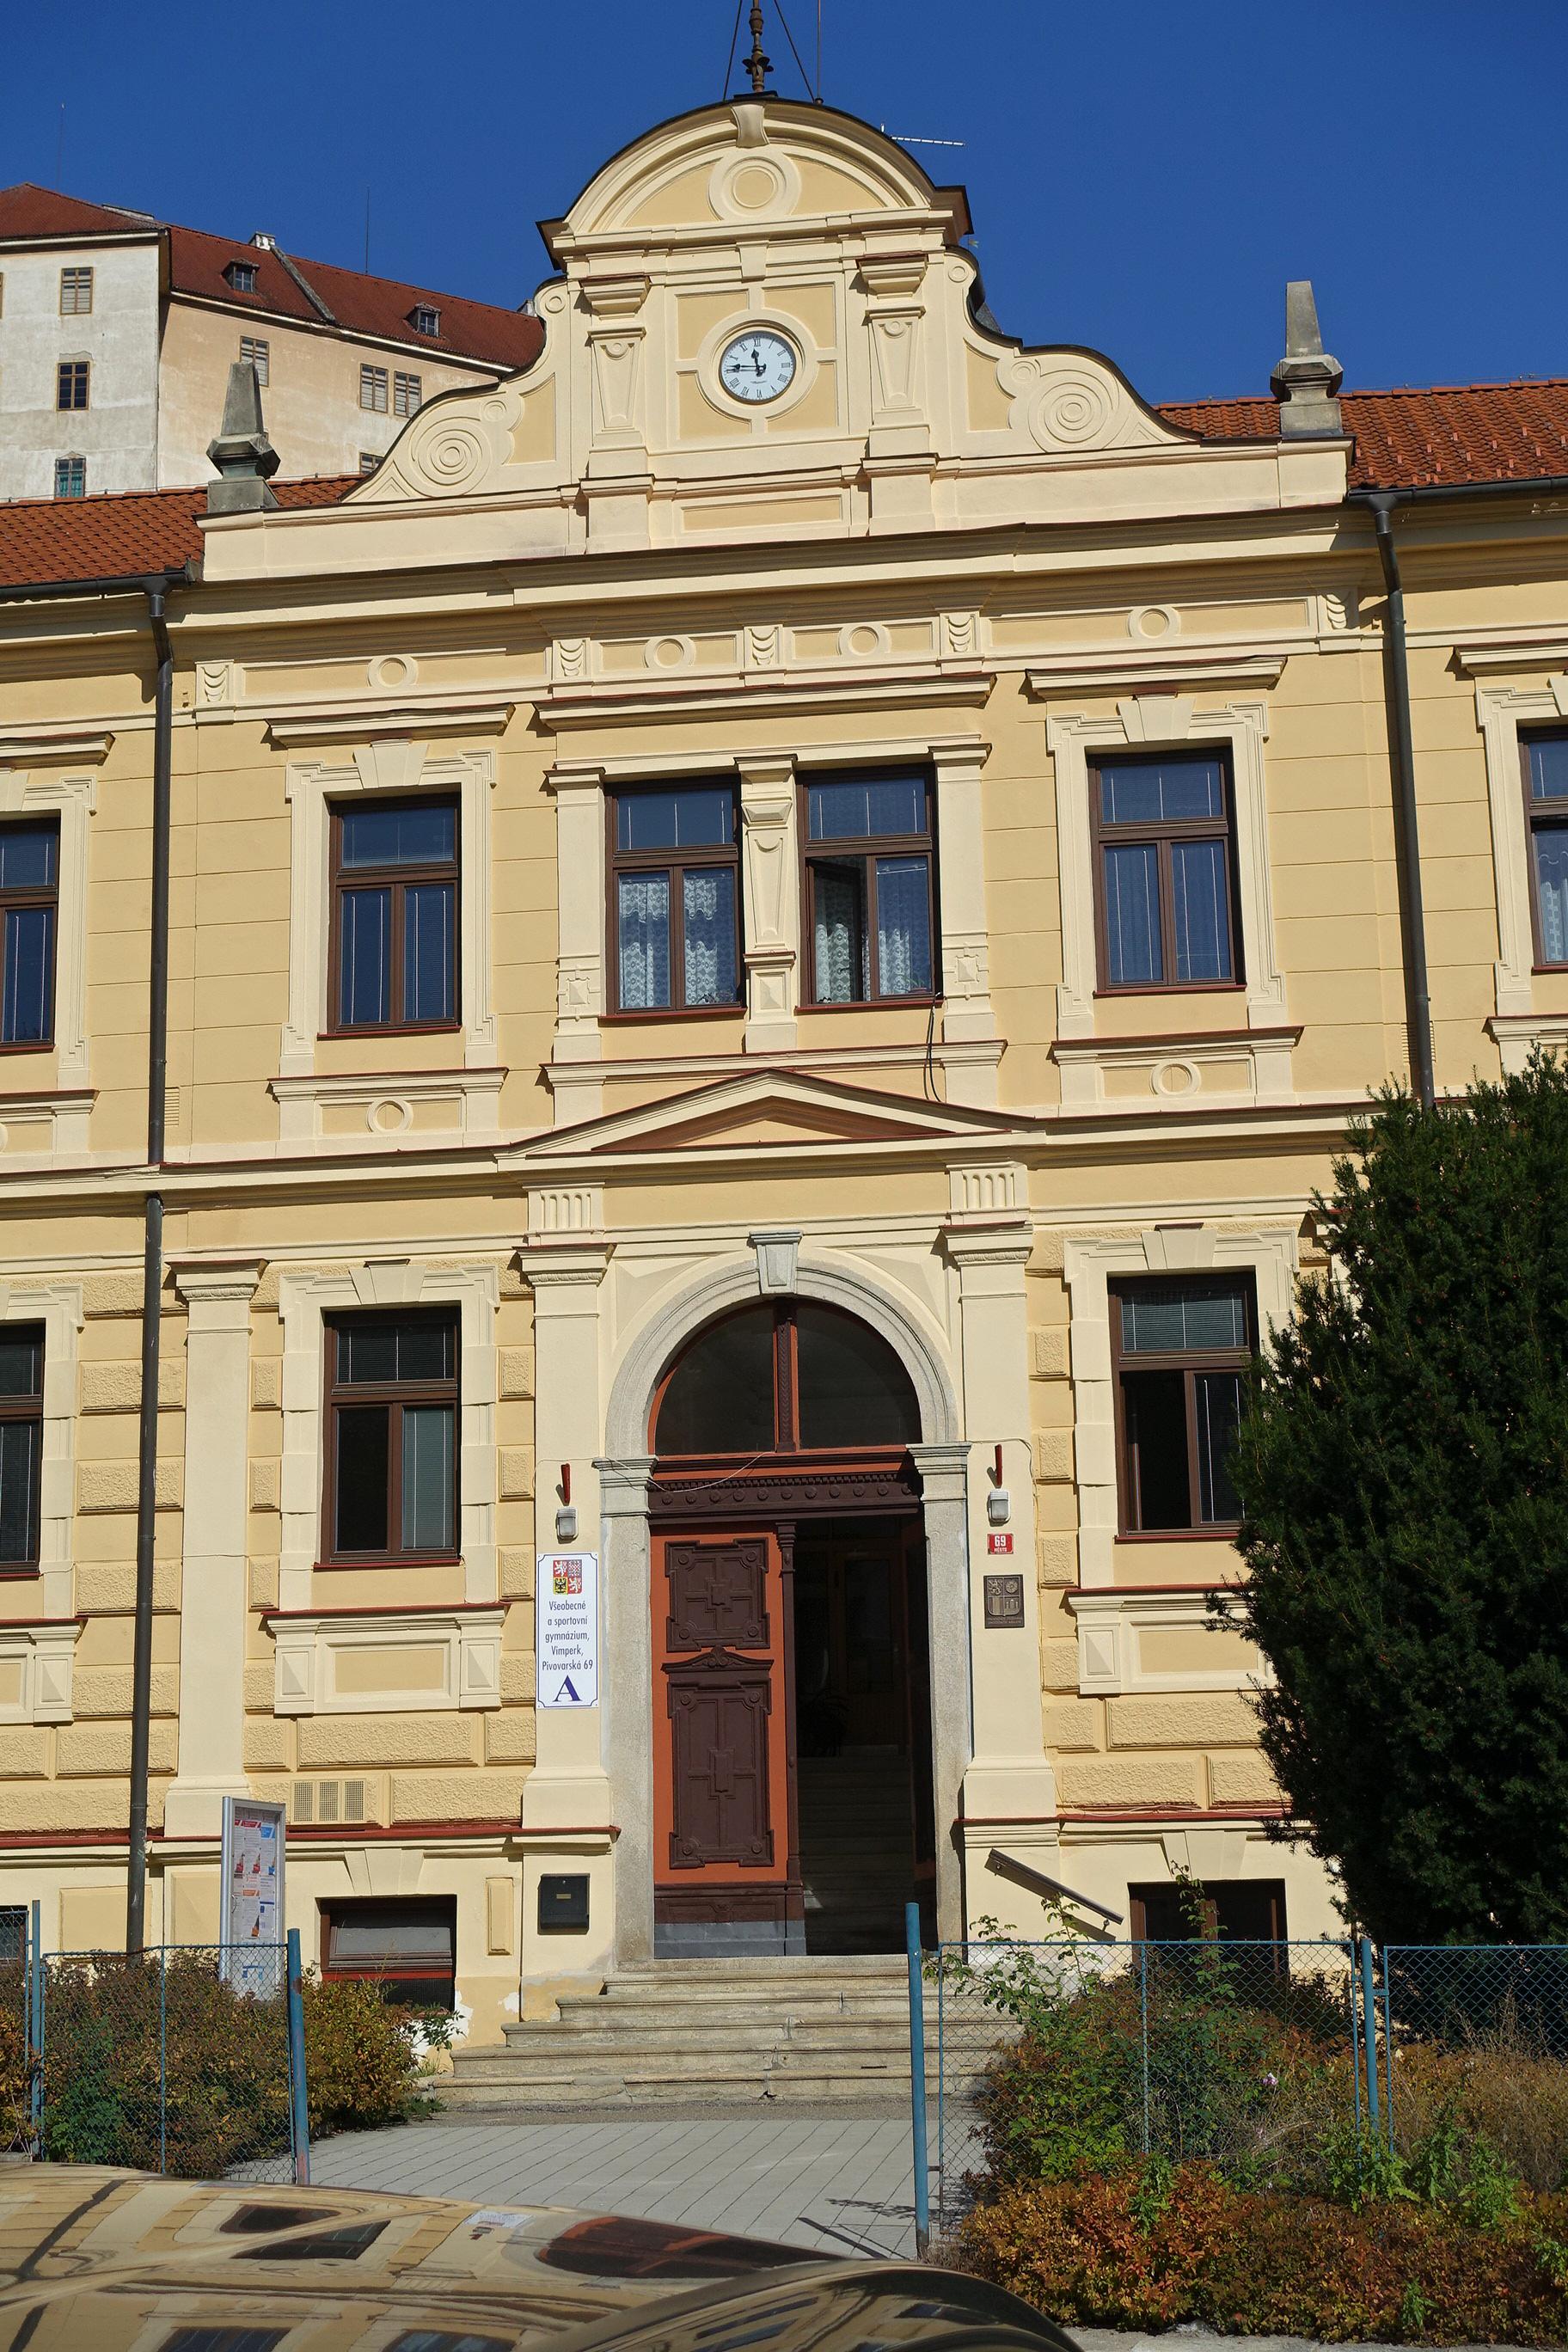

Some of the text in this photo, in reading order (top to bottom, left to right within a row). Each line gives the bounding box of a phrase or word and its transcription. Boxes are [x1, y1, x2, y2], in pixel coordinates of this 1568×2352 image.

[995, 1535, 1007, 1547] 69
[548, 1600, 586, 1611] Všeobecné
[554, 1615, 588, 1627] sportovní
[545, 1630, 590, 1643] gymnázium,
[551, 1645, 585, 1657] Vimperk,
[542, 1659, 593, 1671] Pivovarská 69
[553, 1675, 582, 1702] A
